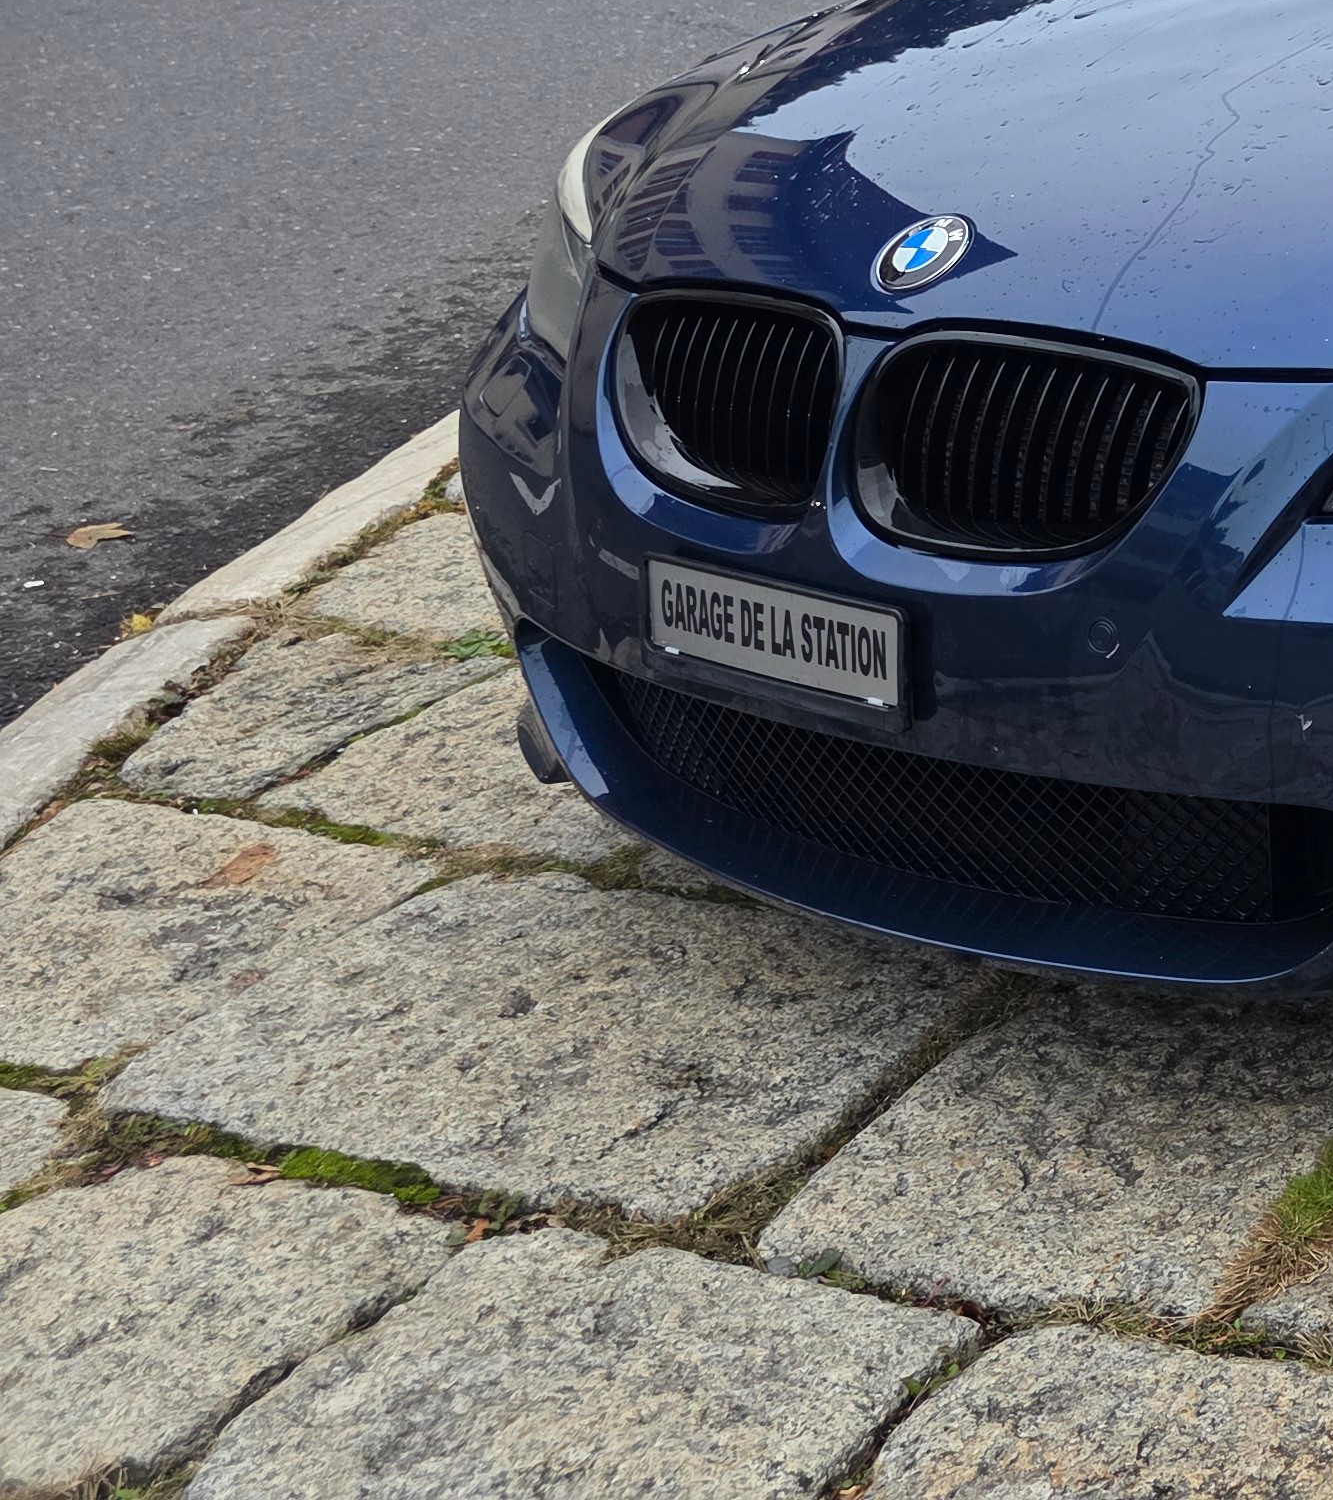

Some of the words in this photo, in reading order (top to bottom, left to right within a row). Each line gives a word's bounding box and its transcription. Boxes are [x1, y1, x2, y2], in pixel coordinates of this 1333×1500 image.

[661, 579, 734, 644] GARAGE
[740, 599, 764, 652] DE
[771, 606, 796, 660] LA
[801, 613, 888, 680] STATION
